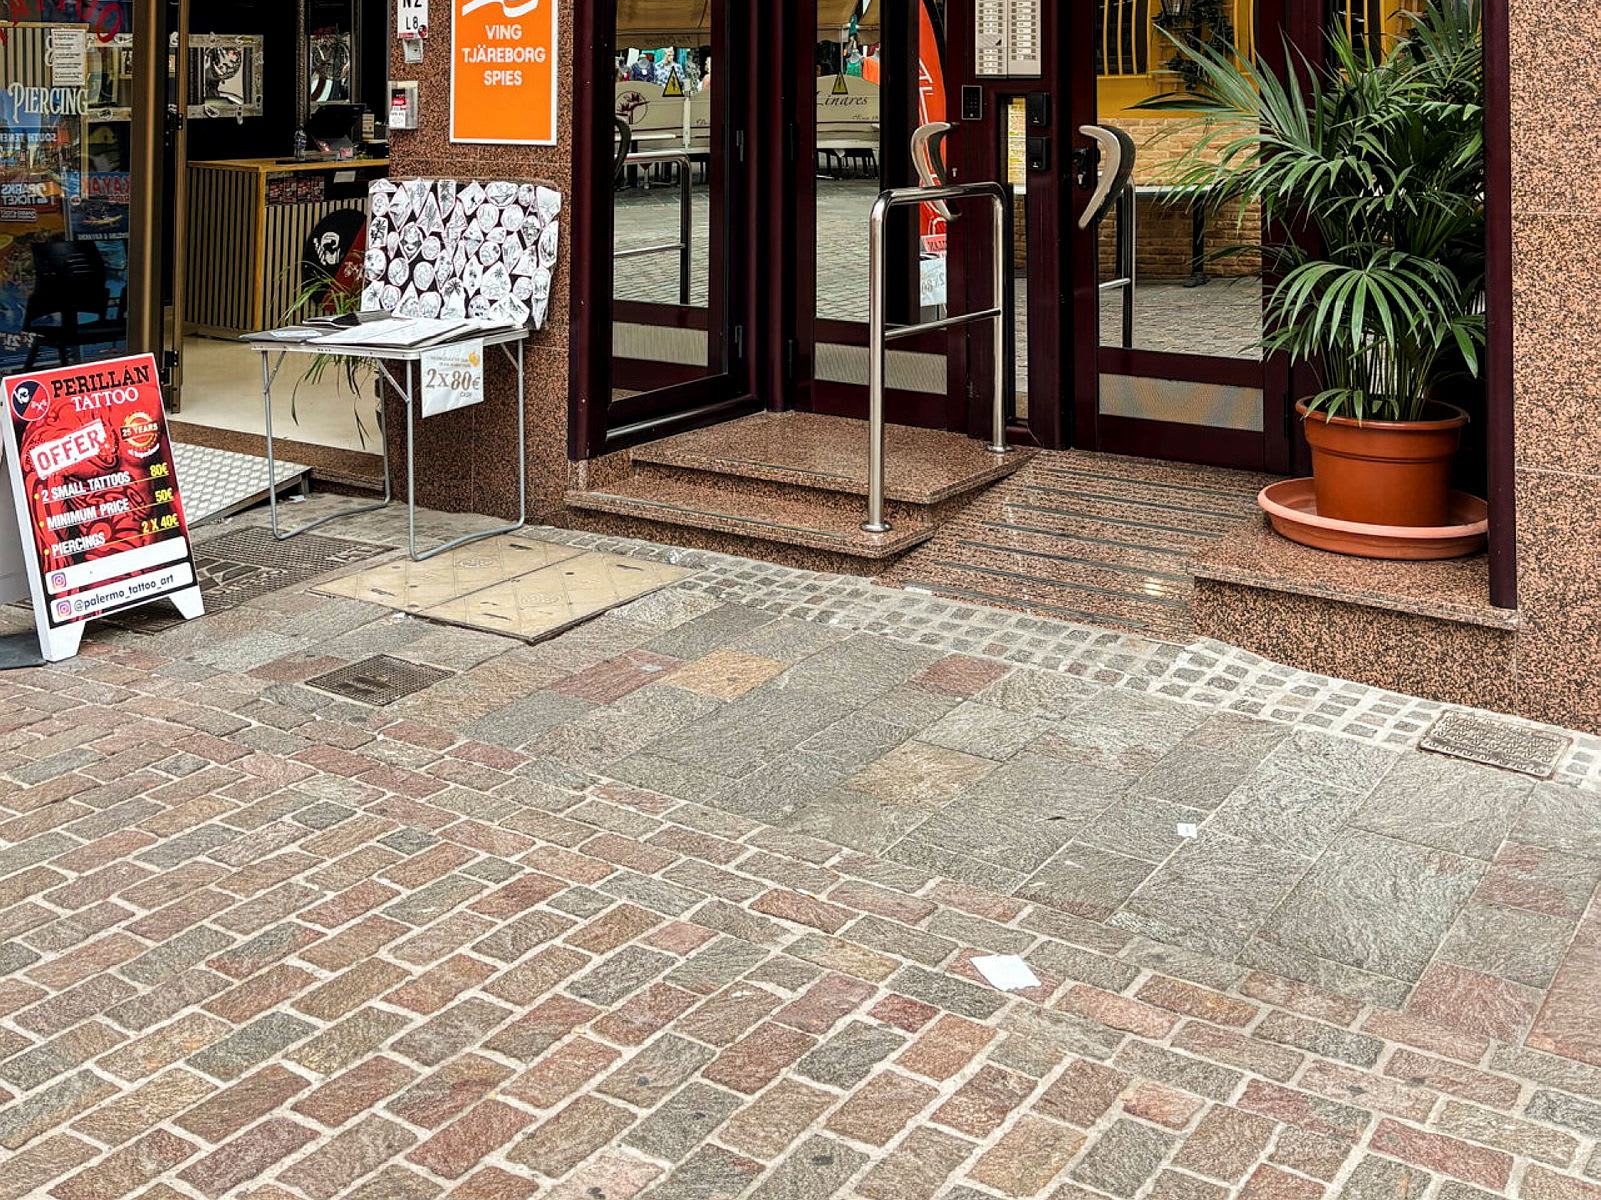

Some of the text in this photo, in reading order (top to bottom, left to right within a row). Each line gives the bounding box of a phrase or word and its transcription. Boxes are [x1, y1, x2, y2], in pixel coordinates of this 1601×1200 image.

[485, 24, 522, 40] VING
[461, 44, 546, 63] TJÄREBORG
[484, 70, 522, 86] SPIES
[7, 82, 90, 124] PIERCING
[51, 365, 150, 398] PERILLÁN
[71, 387, 138, 412] TATTOO
[133, 422, 158, 434] YEARS
[37, 429, 102, 471] OFFER
[41, 463, 169, 501] 2 SMALL TATTOOS 80€
[46, 488, 174, 529] MINIMUM PRICE 50€
[51, 532, 106, 557] PIERCINGS
[141, 521, 149, 534] 2
[160, 513, 180, 528] 40€
[74, 574, 174, 611] @palermo_tattoo_art
